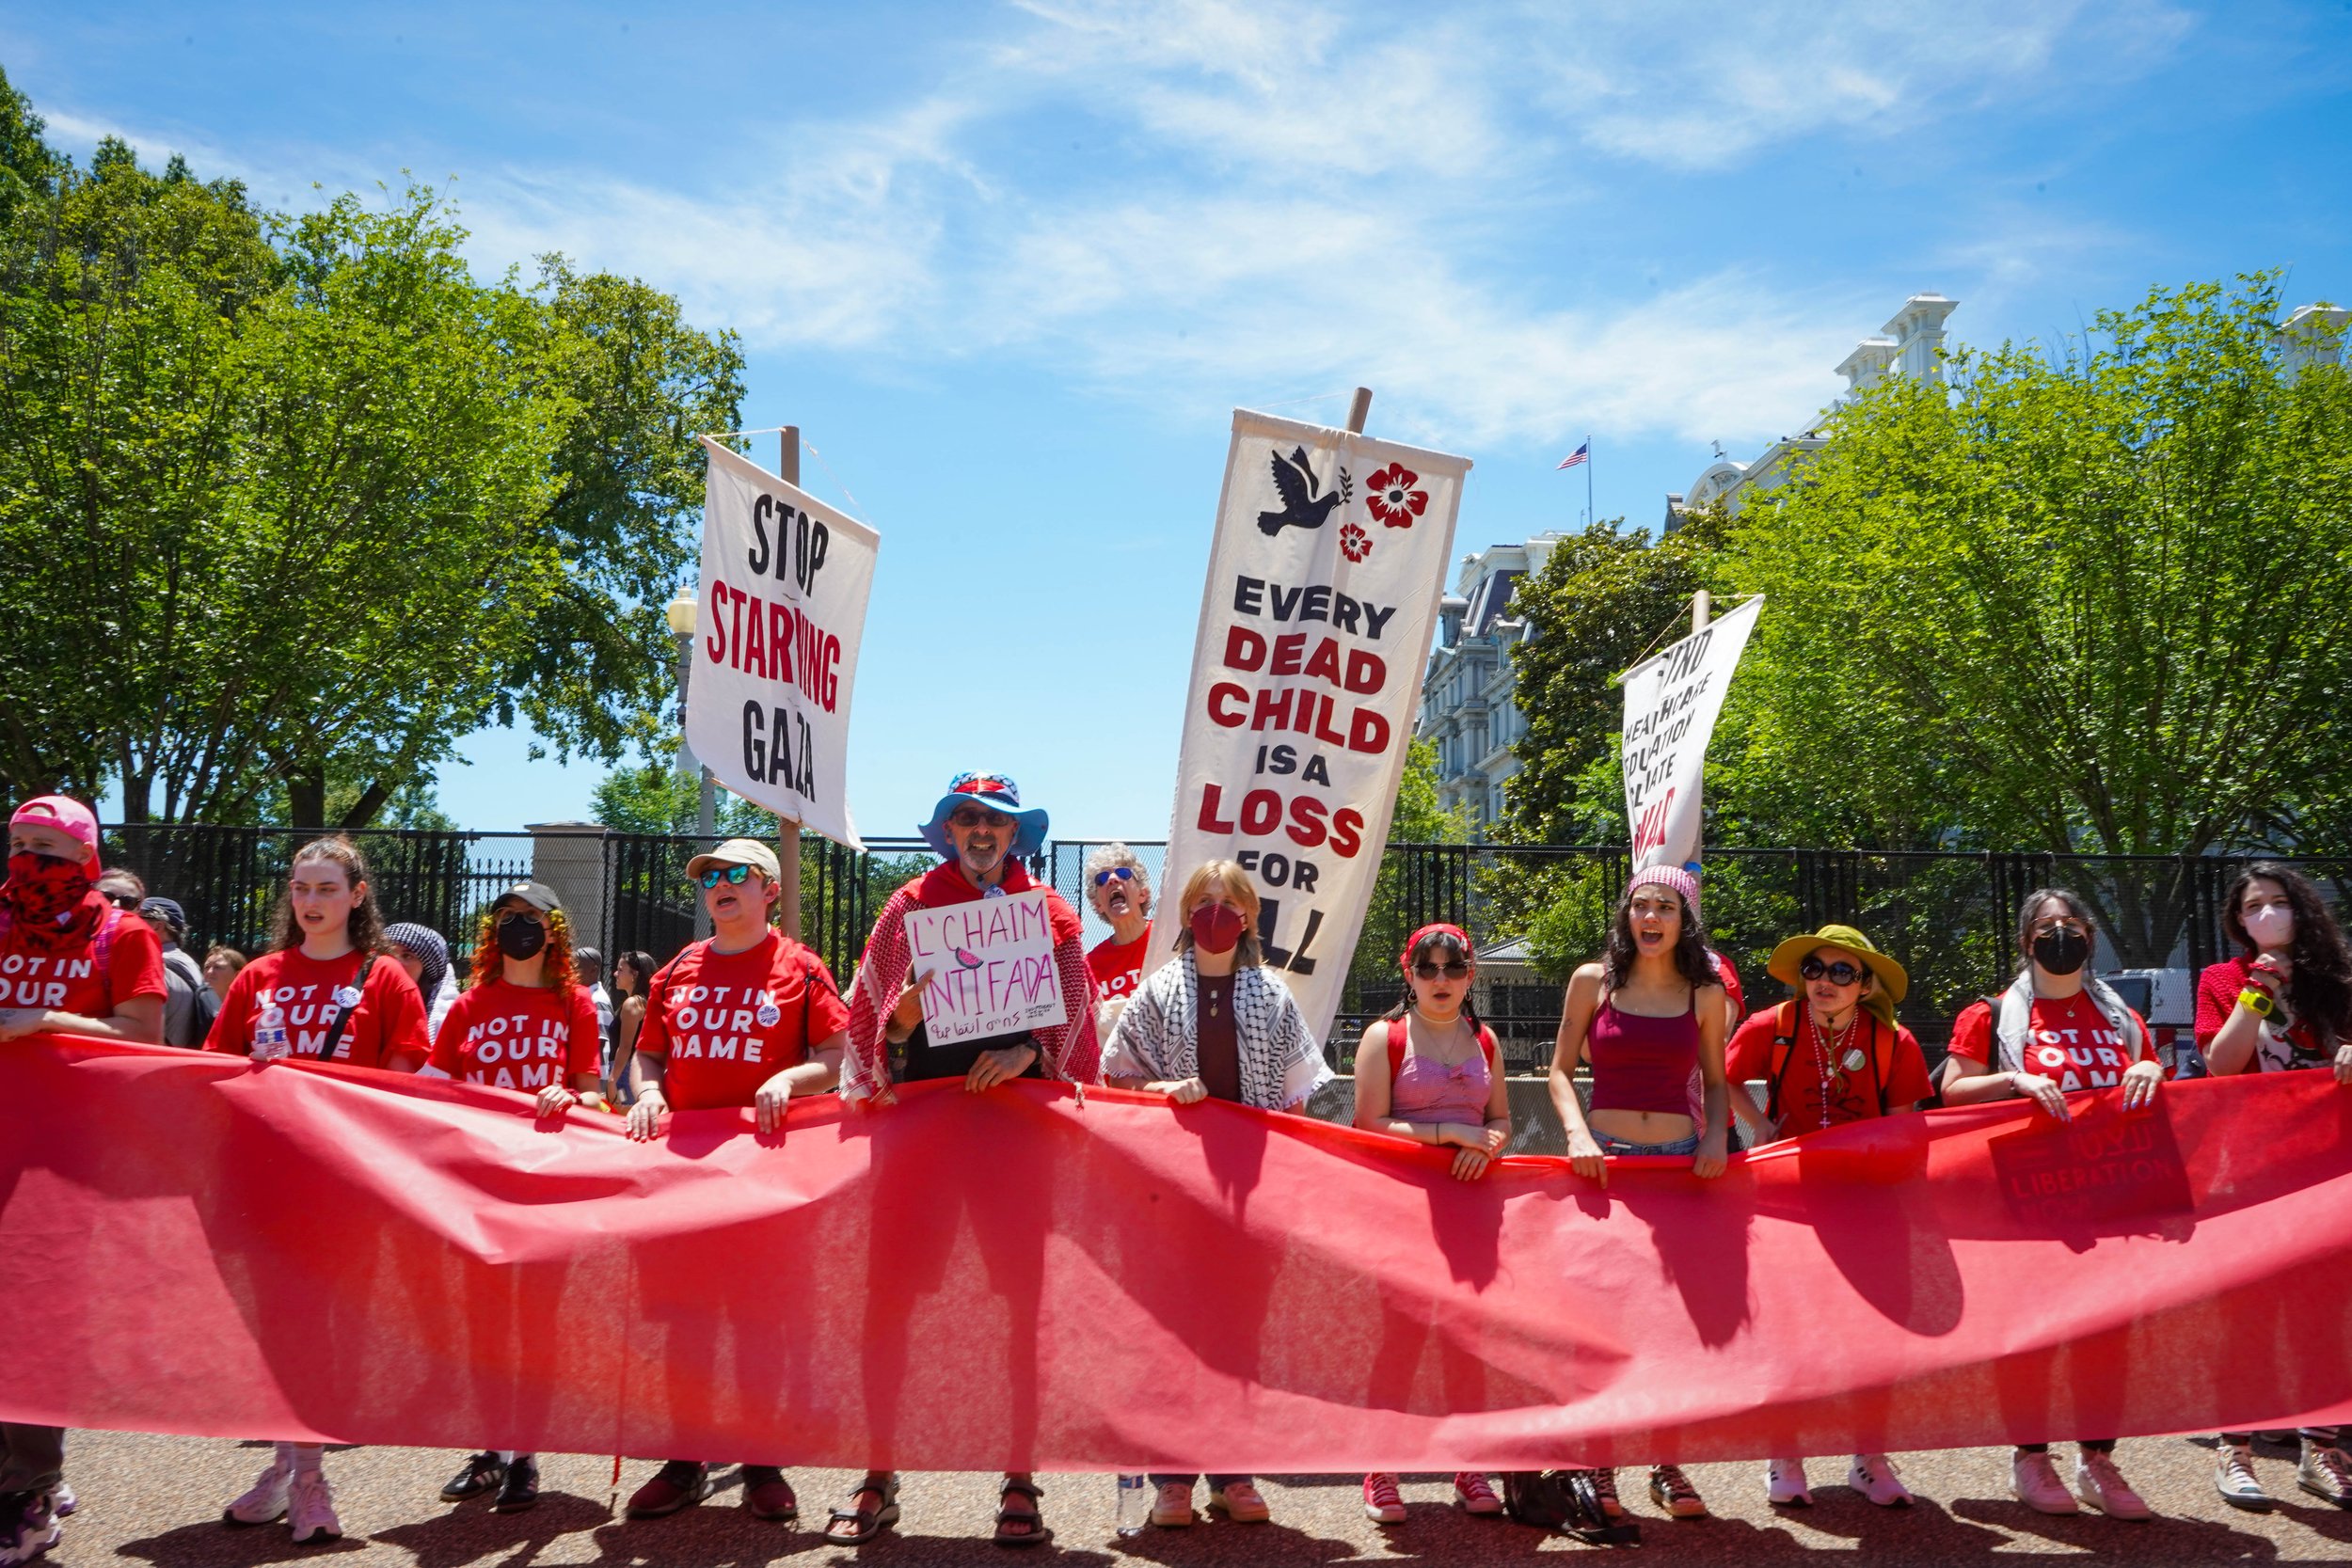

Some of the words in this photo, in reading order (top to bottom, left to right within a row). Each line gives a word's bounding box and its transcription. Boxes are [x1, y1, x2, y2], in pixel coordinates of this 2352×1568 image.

[749, 493, 830, 598] STOP
[1233, 575, 1397, 640] EVERY
[707, 579, 842, 714] STARVING
[1223, 625, 1387, 695] DEAD
[1207, 682, 1391, 754] CHILD
[742, 699, 816, 803] GAZA
[1255, 744, 1297, 775] IS
[1301, 754, 1331, 787] A
[1197, 783, 1364, 859] LOSS
[1236, 850, 1319, 894] FOR
[913, 898, 1048, 957] L'CHAIM
[0, 954, 46, 974] OT
[54, 958, 92, 978] IN
[255, 984, 318, 1009] NOT
[671, 986, 731, 1005] NOT
[742, 988, 776, 1006] IN
[918, 953, 1056, 1023] INTIFADA
[468, 1015, 529, 1042] NOT
[542, 1020, 569, 1041] IN
[676, 1006, 754, 1033] OUR
[2091, 1030, 2123, 1046] IN
[477, 1037, 557, 1063] OUR
[672, 1035, 764, 1063] NAME
[2038, 1047, 2122, 1068] OUR
[467, 1063, 564, 1089] NAME
